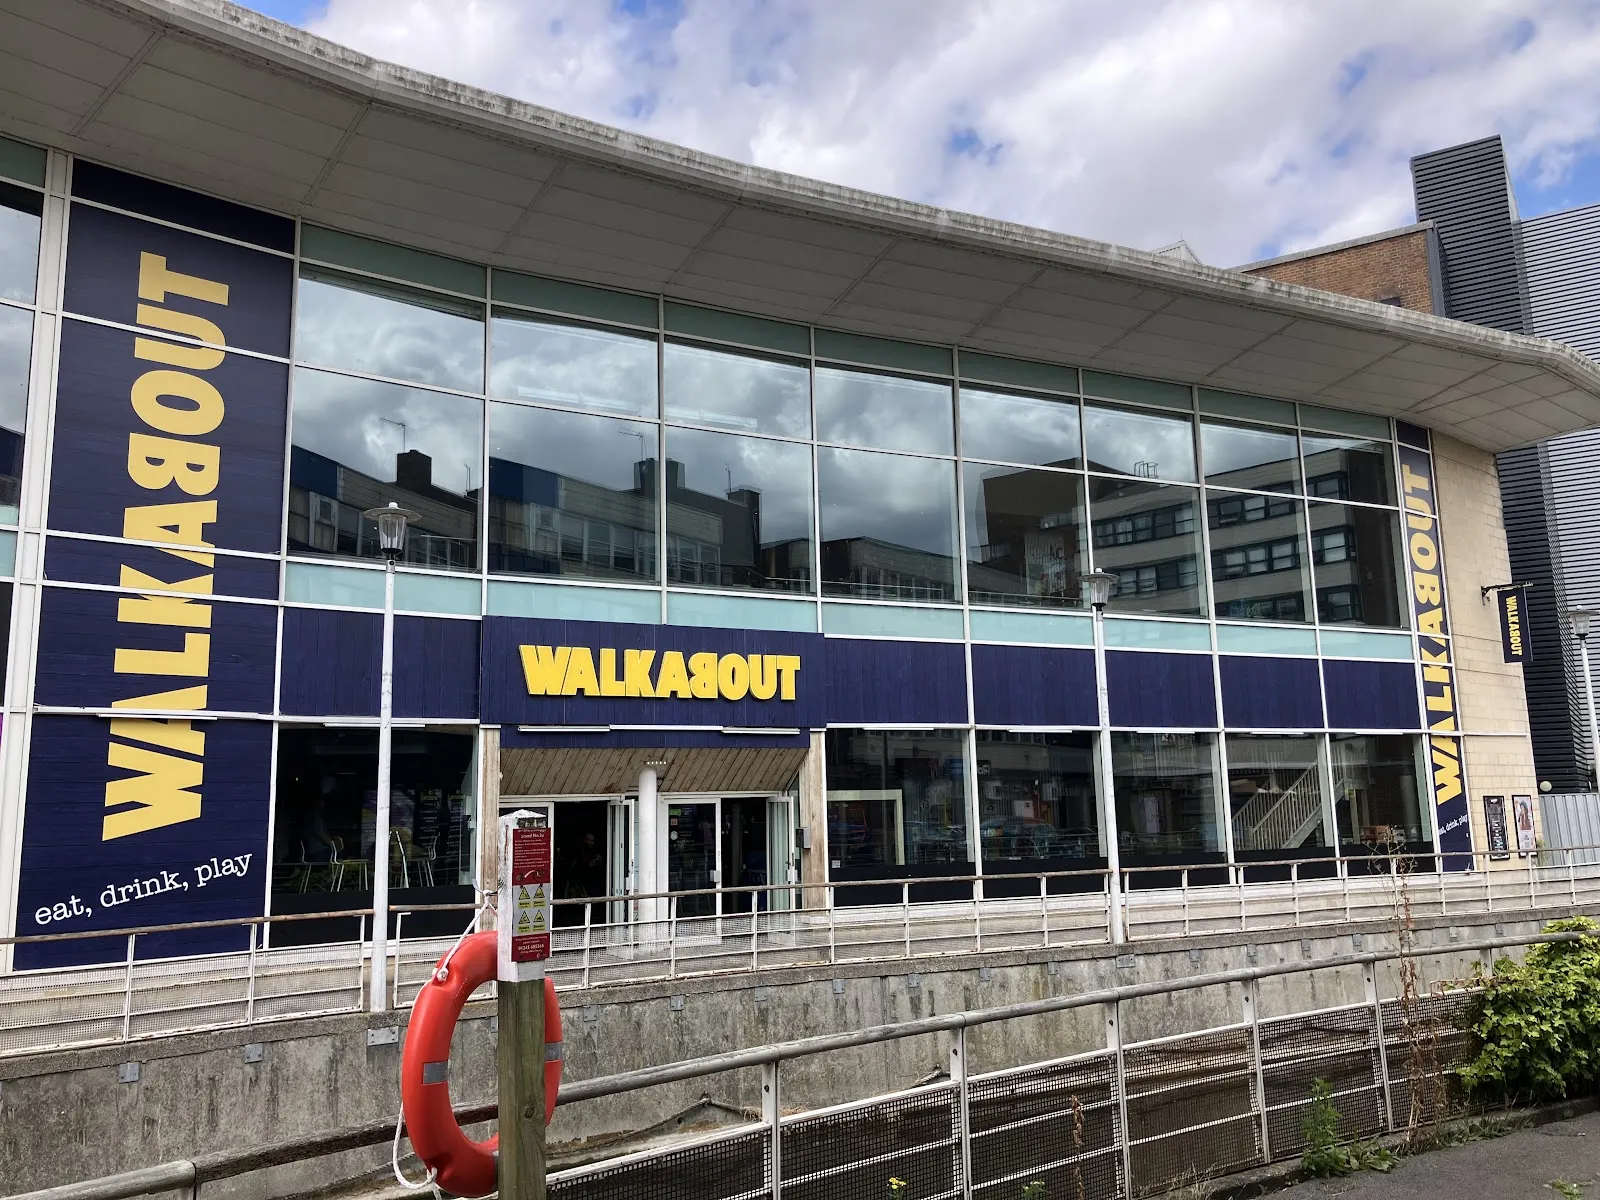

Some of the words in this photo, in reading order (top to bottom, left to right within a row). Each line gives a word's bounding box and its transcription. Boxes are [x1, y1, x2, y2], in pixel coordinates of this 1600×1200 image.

[102, 252, 229, 841] WALKABOUT
[1402, 464, 1462, 806] WALKABOUT
[1505, 595, 1523, 656] WALKABOUT
[519, 644, 801, 701] WALKABOUT
[35, 894, 93, 925] eat,
[100, 870, 189, 908] drink,
[193, 853, 253, 888] play
